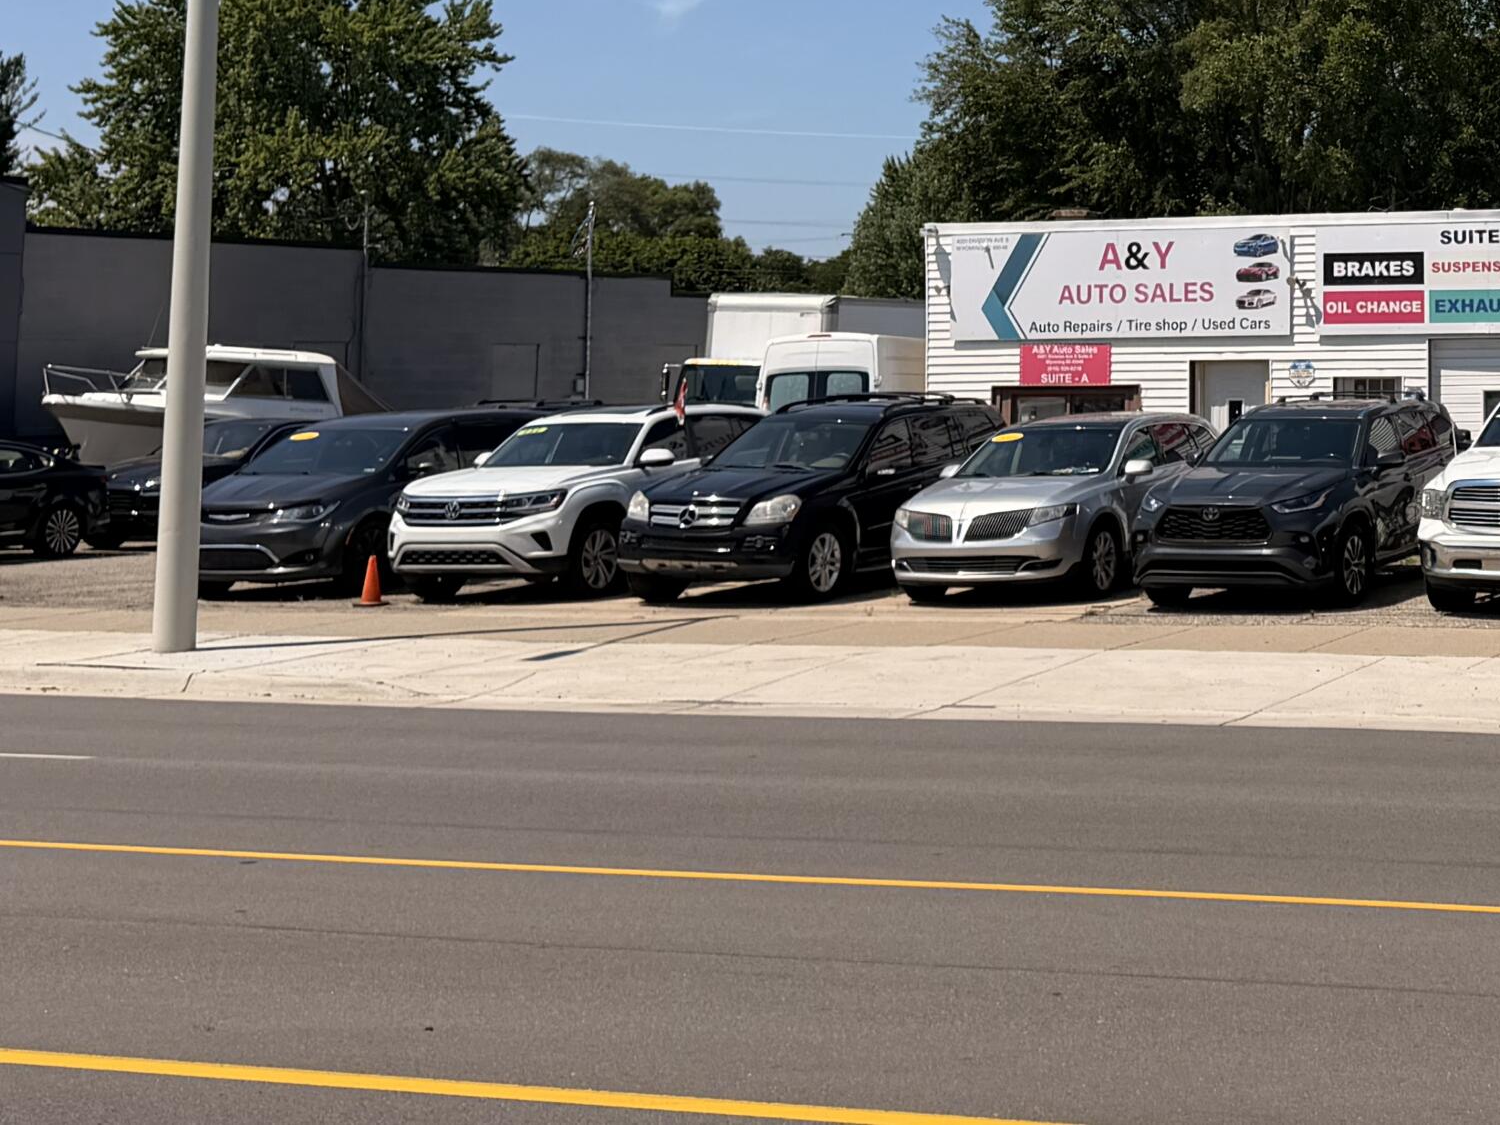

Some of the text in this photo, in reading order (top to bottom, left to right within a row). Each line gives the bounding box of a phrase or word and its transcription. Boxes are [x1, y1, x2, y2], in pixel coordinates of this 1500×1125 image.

[1440, 229, 1500, 245] SUITE
[1098, 241, 1175, 271] A&Y
[1333, 260, 1415, 277] BRAKES
[1058, 281, 1215, 306] AUTO SALES
[1326, 299, 1422, 315] OIL CHANGE
[1029, 321, 1058, 333] Auto
[1063, 319, 1113, 336] Repairs
[1127, 319, 1151, 332] Tire
[1155, 319, 1188, 335] shop
[1201, 317, 1235, 330] Used
[1239, 316, 1271, 330] Cars
[1052, 345, 1073, 354] Auto
[1074, 345, 1098, 354] Sales
[1040, 373, 1072, 384] SUITE
[1080, 372, 1089, 383] A
